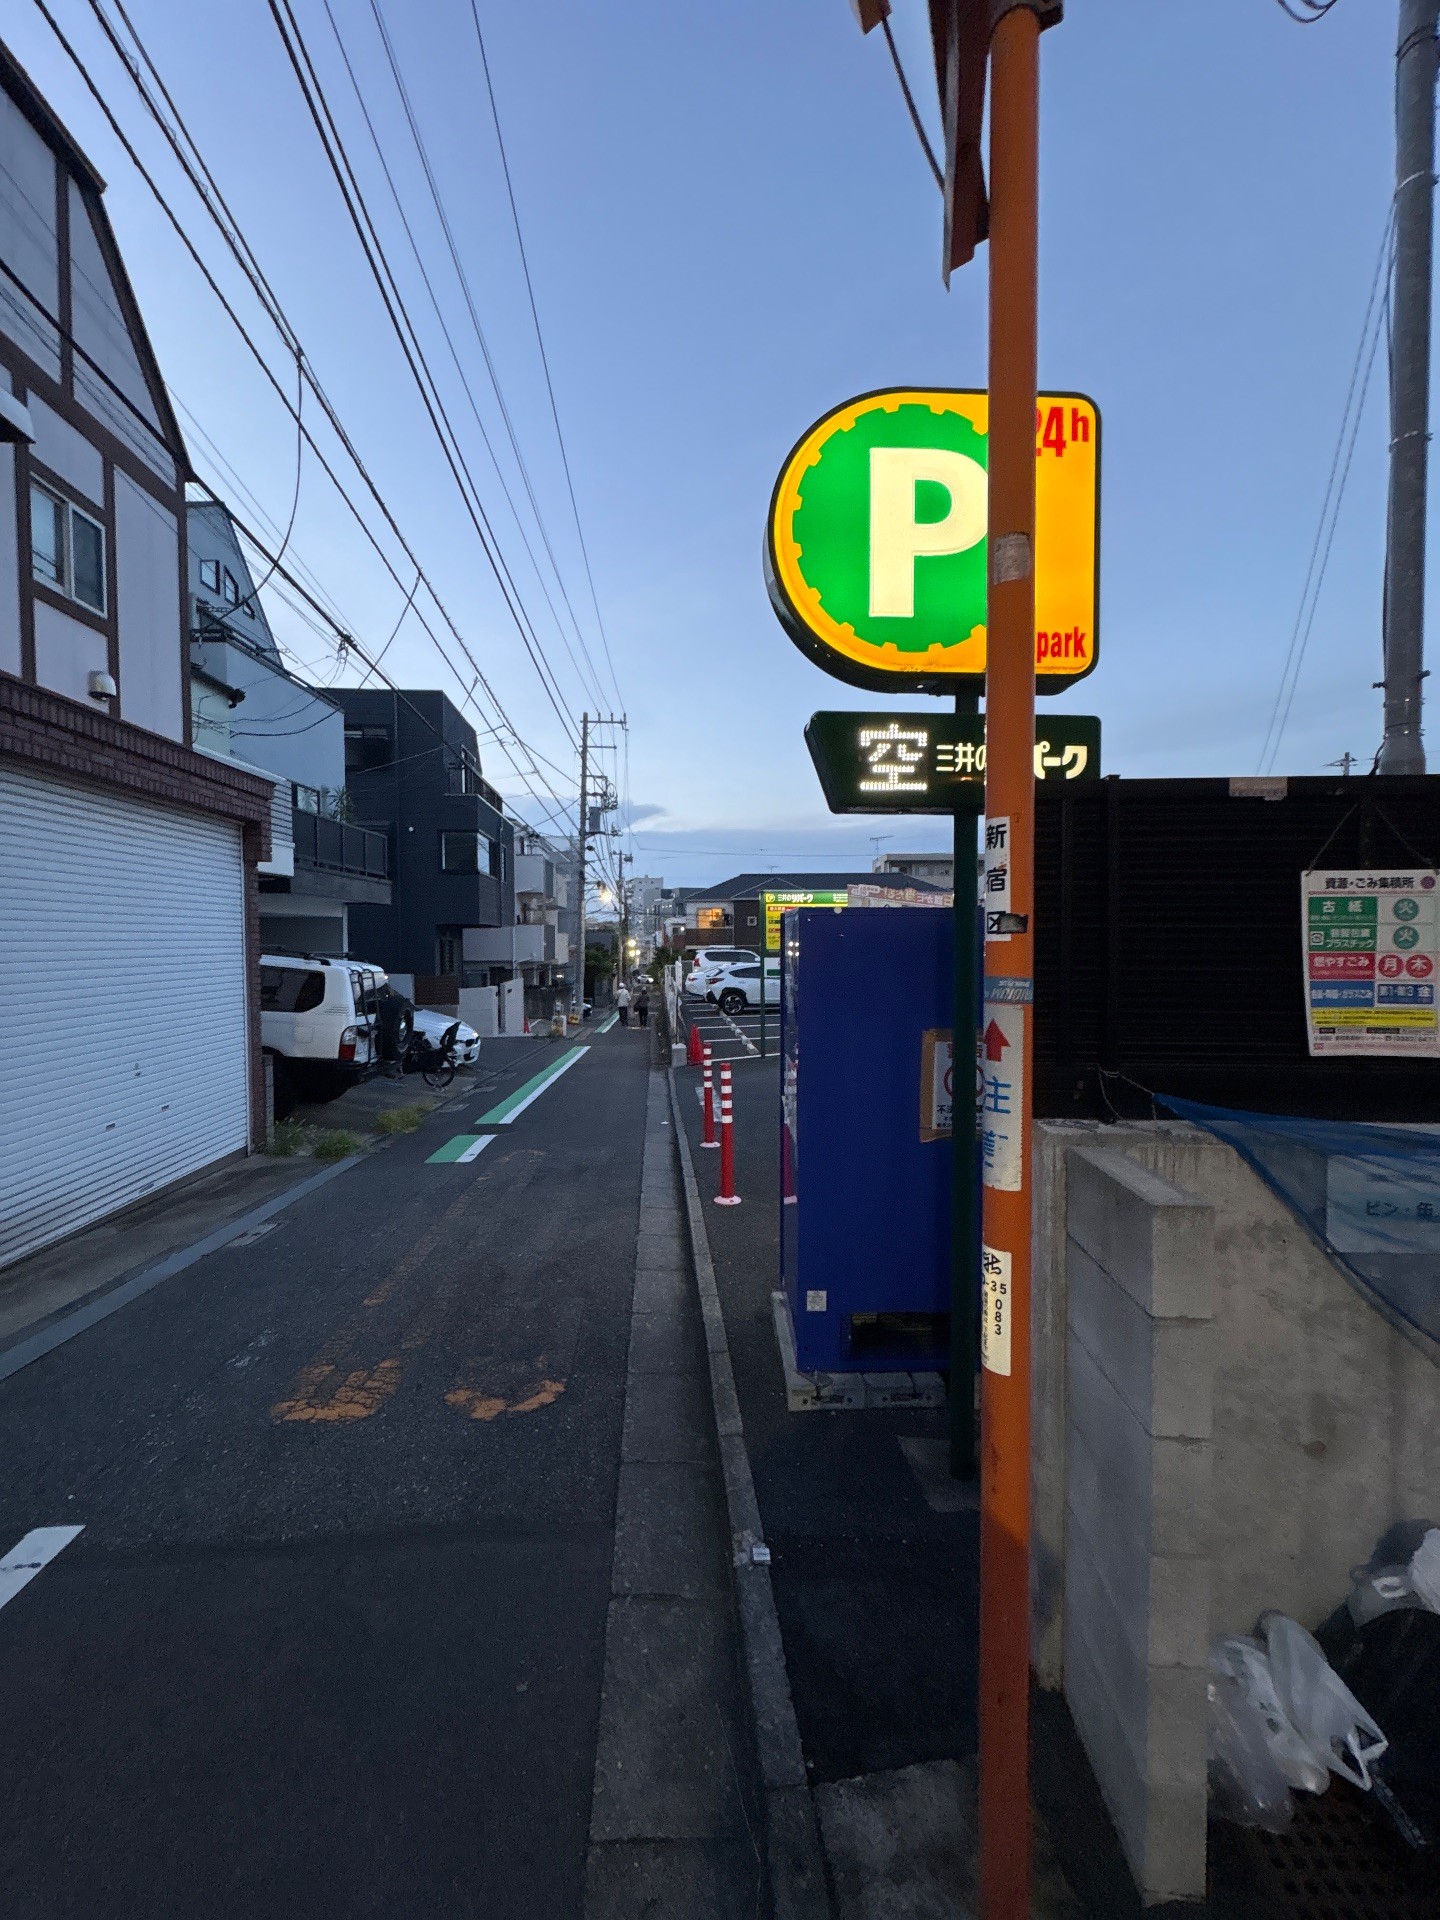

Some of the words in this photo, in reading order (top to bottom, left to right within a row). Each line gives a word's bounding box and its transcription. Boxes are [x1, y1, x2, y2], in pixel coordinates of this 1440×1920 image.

[869, 447, 988, 618] P
[860, 724, 928, 792] 空
[1384, 957, 1397, 971] 月
[1412, 957, 1427, 972] 木
